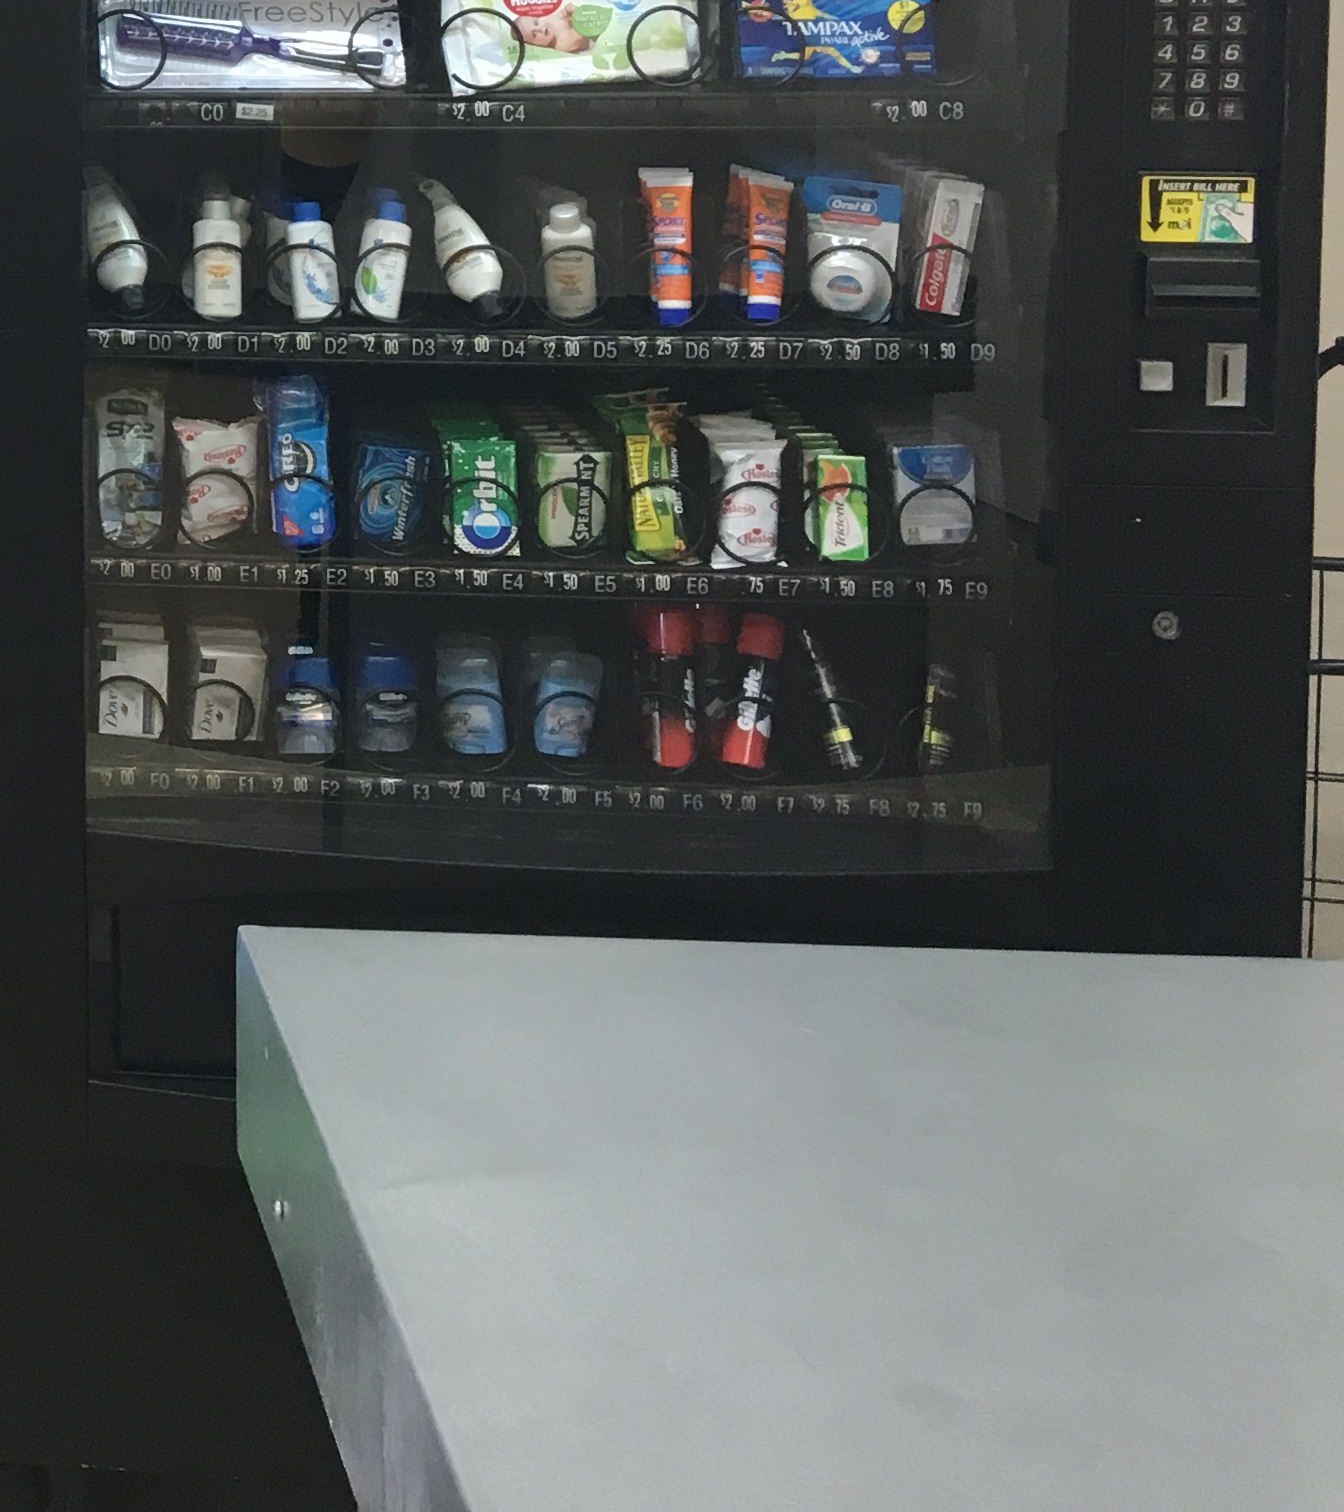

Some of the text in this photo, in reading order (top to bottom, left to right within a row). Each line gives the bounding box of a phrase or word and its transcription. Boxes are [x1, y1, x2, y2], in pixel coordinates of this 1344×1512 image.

[239, 0, 385, 27] FreeStyle
[782, 21, 863, 37] TAMPAX
[850, 27, 890, 47] active
[502, 104, 526, 122] C4
[1158, 179, 1240, 192] INSERT BILL HERE
[924, 247, 948, 307] Colgate
[594, 342, 617, 358] D5
[970, 344, 995, 361] D9
[279, 432, 299, 492] OREO
[834, 500, 846, 548] Trident
[502, 573, 524, 590] E4
[872, 580, 894, 598] E8
